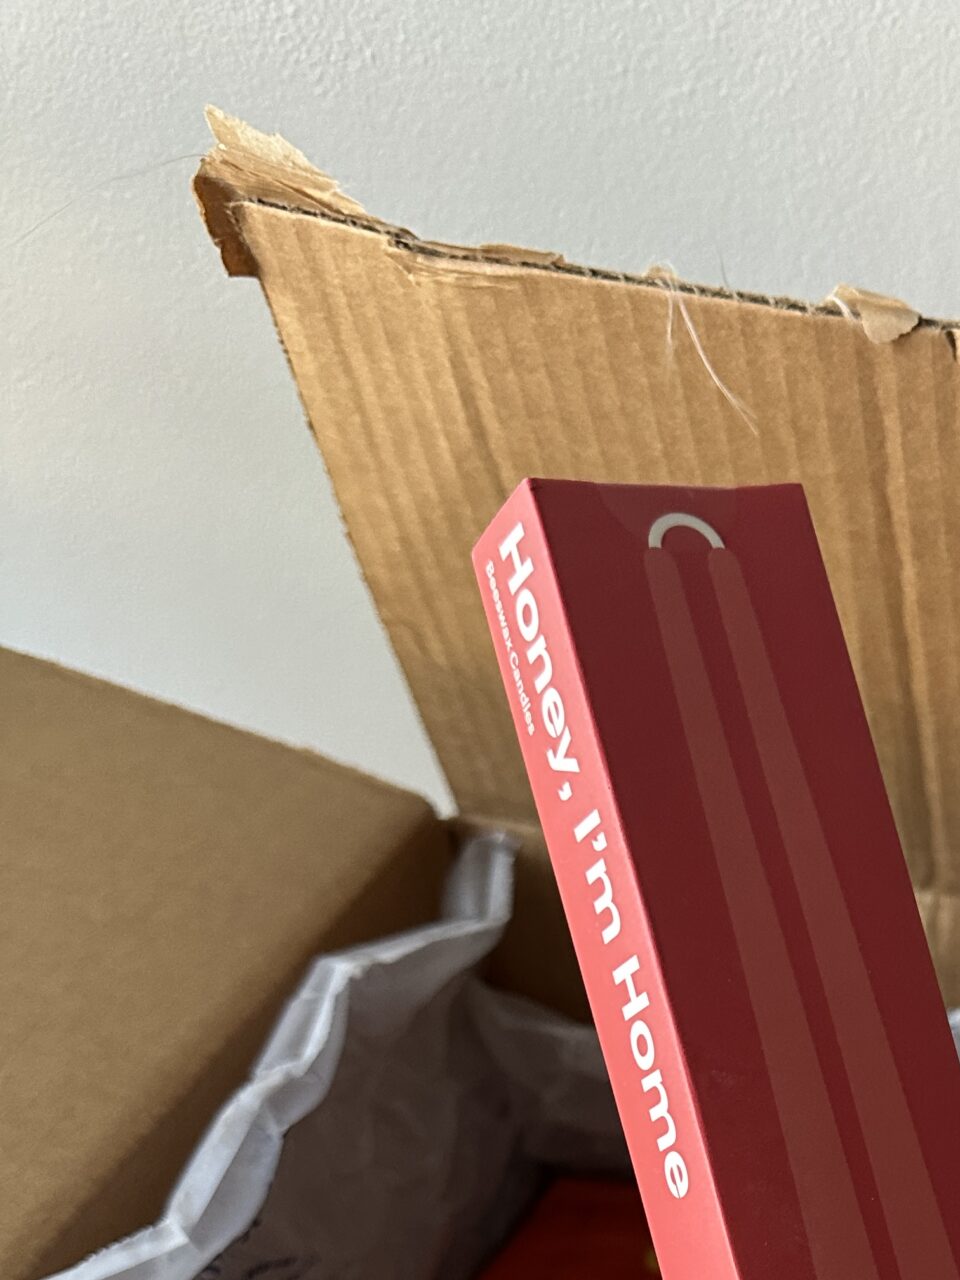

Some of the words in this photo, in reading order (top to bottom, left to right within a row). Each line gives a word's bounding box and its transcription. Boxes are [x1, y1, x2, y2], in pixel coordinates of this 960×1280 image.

[484, 559, 513, 649] Beeswax
[508, 649, 536, 737] Candles
[499, 521, 580, 801] Honey,
[573, 808, 622, 945] I'm
[612, 954, 689, 1200] Home
